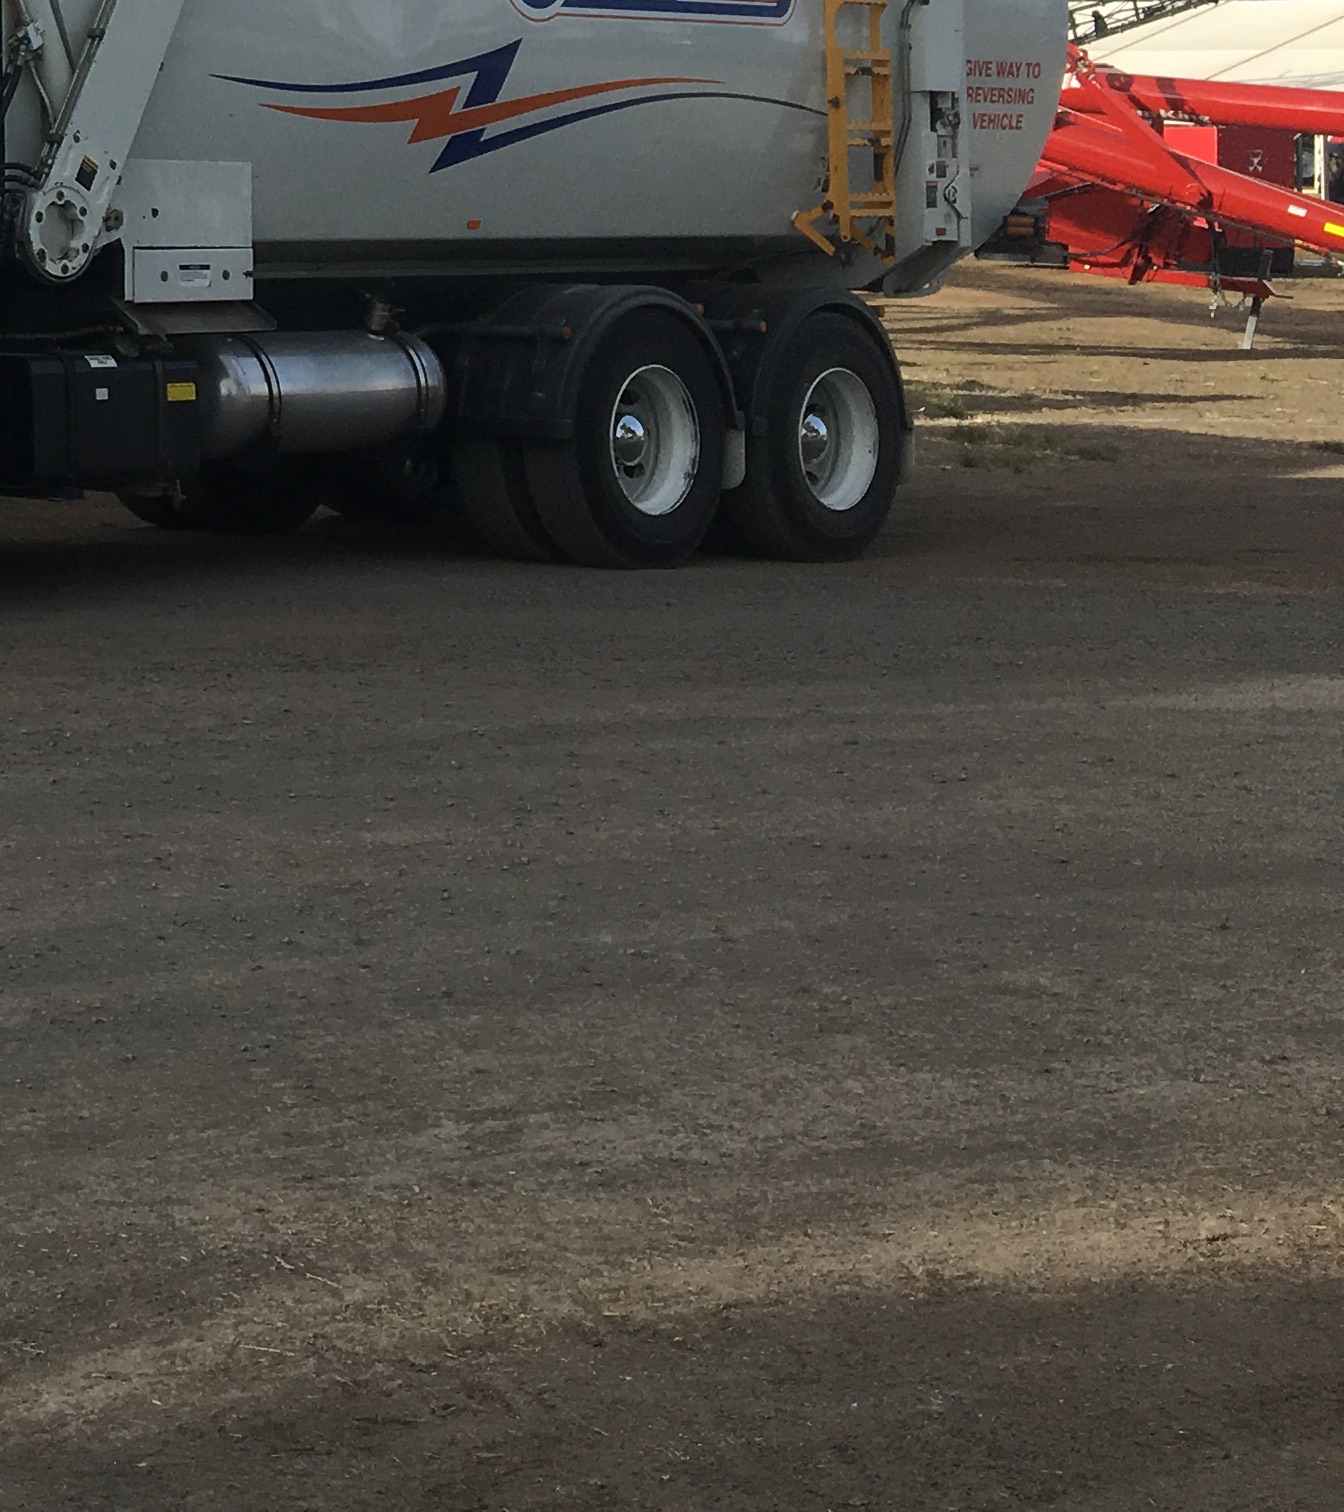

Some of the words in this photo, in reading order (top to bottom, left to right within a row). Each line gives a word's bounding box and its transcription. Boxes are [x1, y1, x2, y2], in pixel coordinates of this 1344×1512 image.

[966, 59, 993, 78] GIVE
[996, 61, 1023, 78] WAY
[1025, 62, 1041, 79] TO
[966, 86, 1034, 104] REVERSING
[972, 113, 1024, 130] VEHICLE
